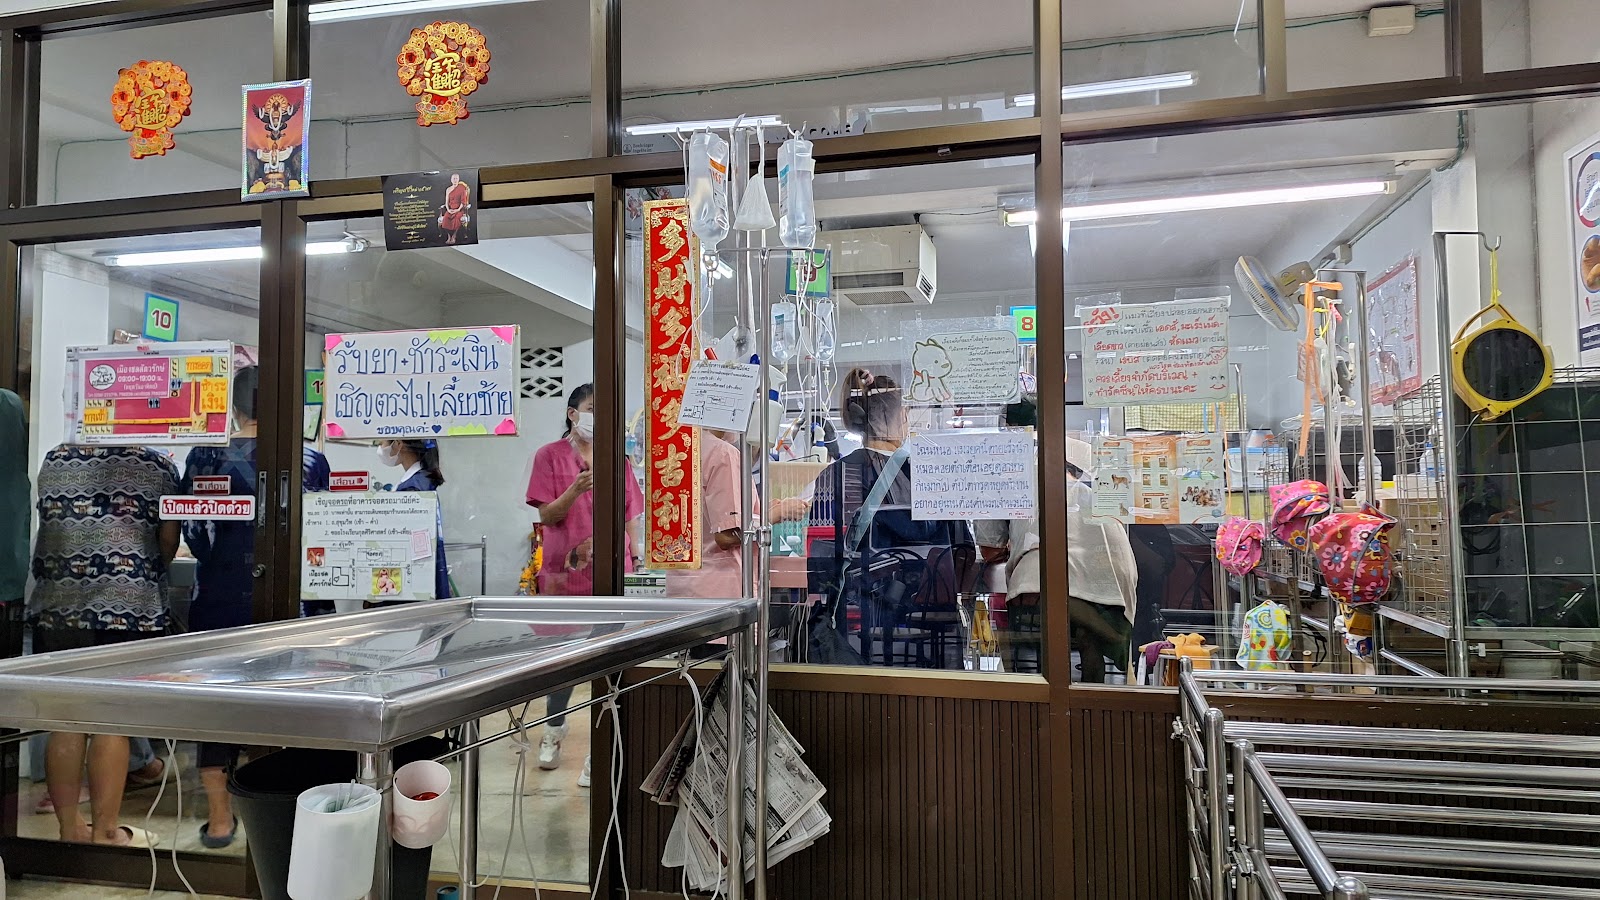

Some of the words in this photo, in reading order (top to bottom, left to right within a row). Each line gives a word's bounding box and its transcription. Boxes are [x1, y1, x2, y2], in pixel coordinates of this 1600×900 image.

[152, 309, 172, 329] 10
[1021, 316, 1034, 331] 8
[312, 380, 324, 394] 1
[162, 499, 251, 515] เปิดแล้วปิดด้วย
